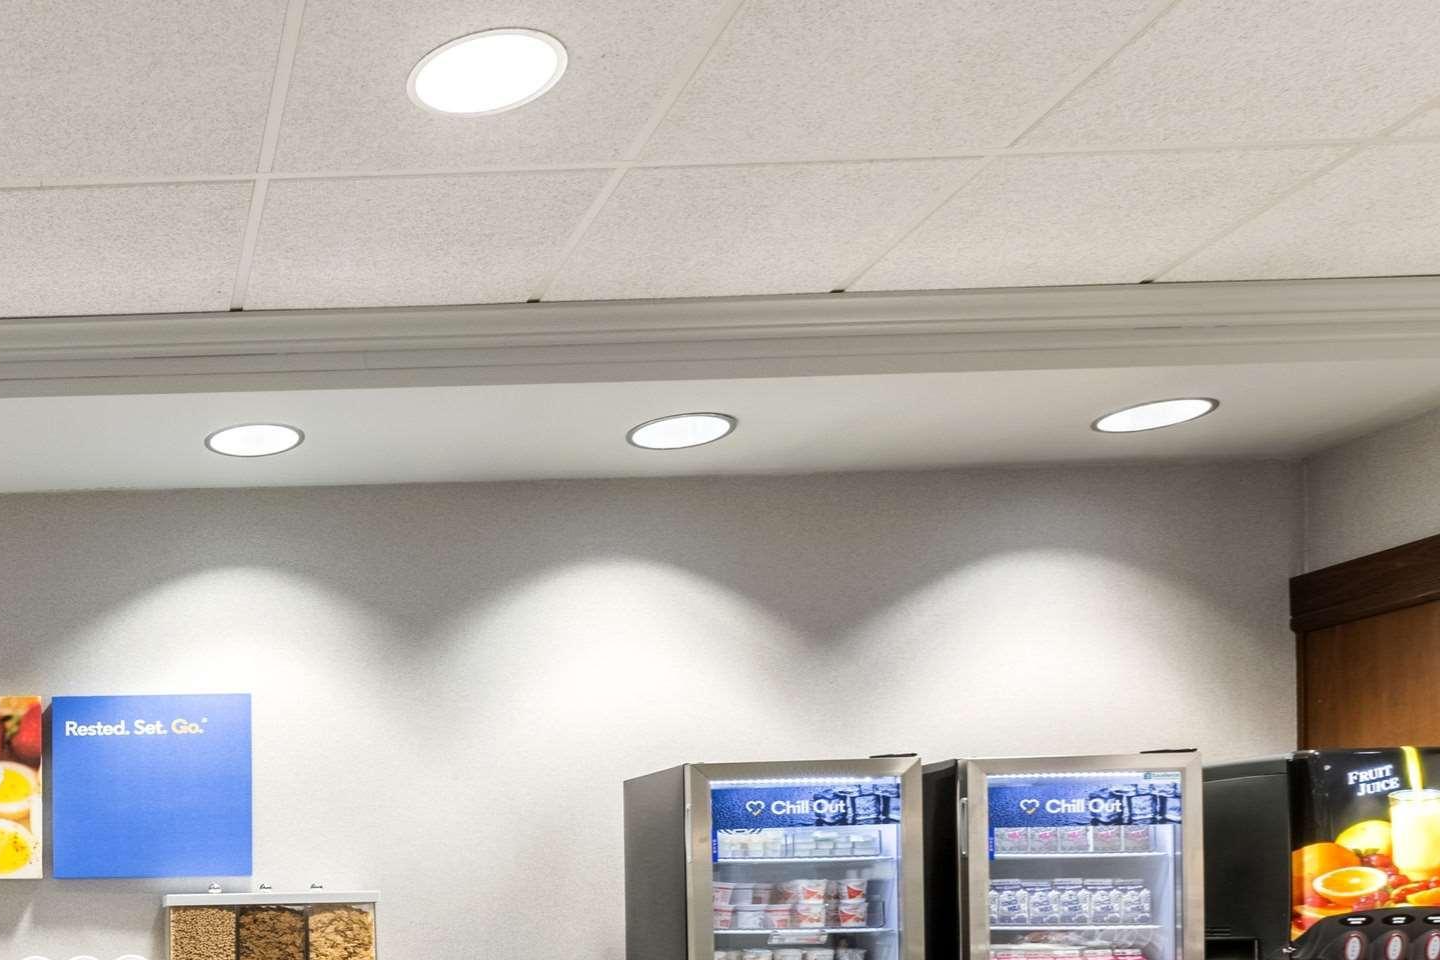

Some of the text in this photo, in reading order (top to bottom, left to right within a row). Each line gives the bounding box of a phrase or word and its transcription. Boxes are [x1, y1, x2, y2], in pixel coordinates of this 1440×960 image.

[65, 719, 131, 737] Rested.
[133, 719, 168, 736] Set.
[1347, 764, 1393, 785] FRUIT
[1357, 777, 1400, 796] JUICE
[770, 799, 846, 815] Chill Out
[1045, 798, 1122, 814] Chill Out
